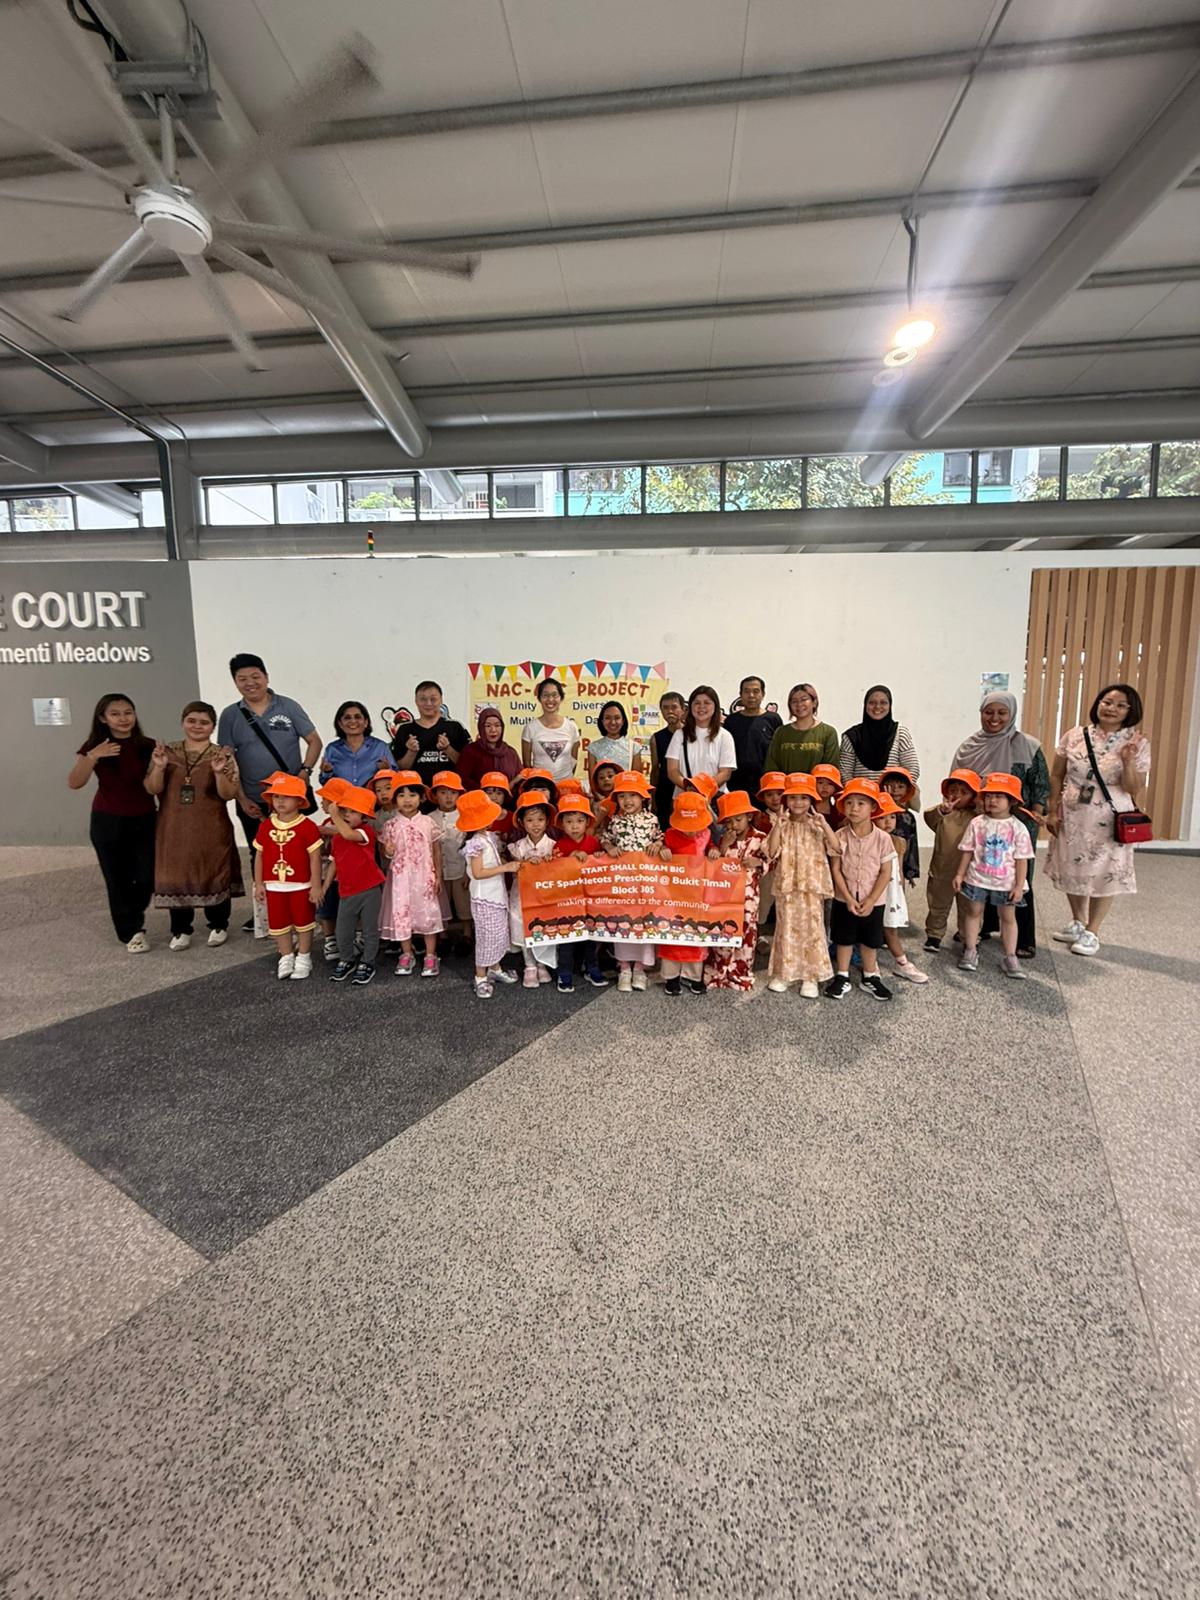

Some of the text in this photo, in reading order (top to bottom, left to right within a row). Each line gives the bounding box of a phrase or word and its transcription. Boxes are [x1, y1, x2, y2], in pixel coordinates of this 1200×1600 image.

[12, 591, 145, 628] COURT
[56, 642, 150, 662] Meadows
[577, 682, 650, 697] PROJECT
[510, 702, 537, 711] Unity
[581, 866, 608, 874] START
[610, 863, 637, 872] SMALL
[639, 864, 668, 872] DREAM
[535, 874, 731, 890] PCF Sparkletots Preschool @ Bukit Timah
[612, 885, 655, 894] Block 305
[557, 898, 586, 908] making
[595, 897, 636, 905] difference
[663, 899, 710, 911] community
